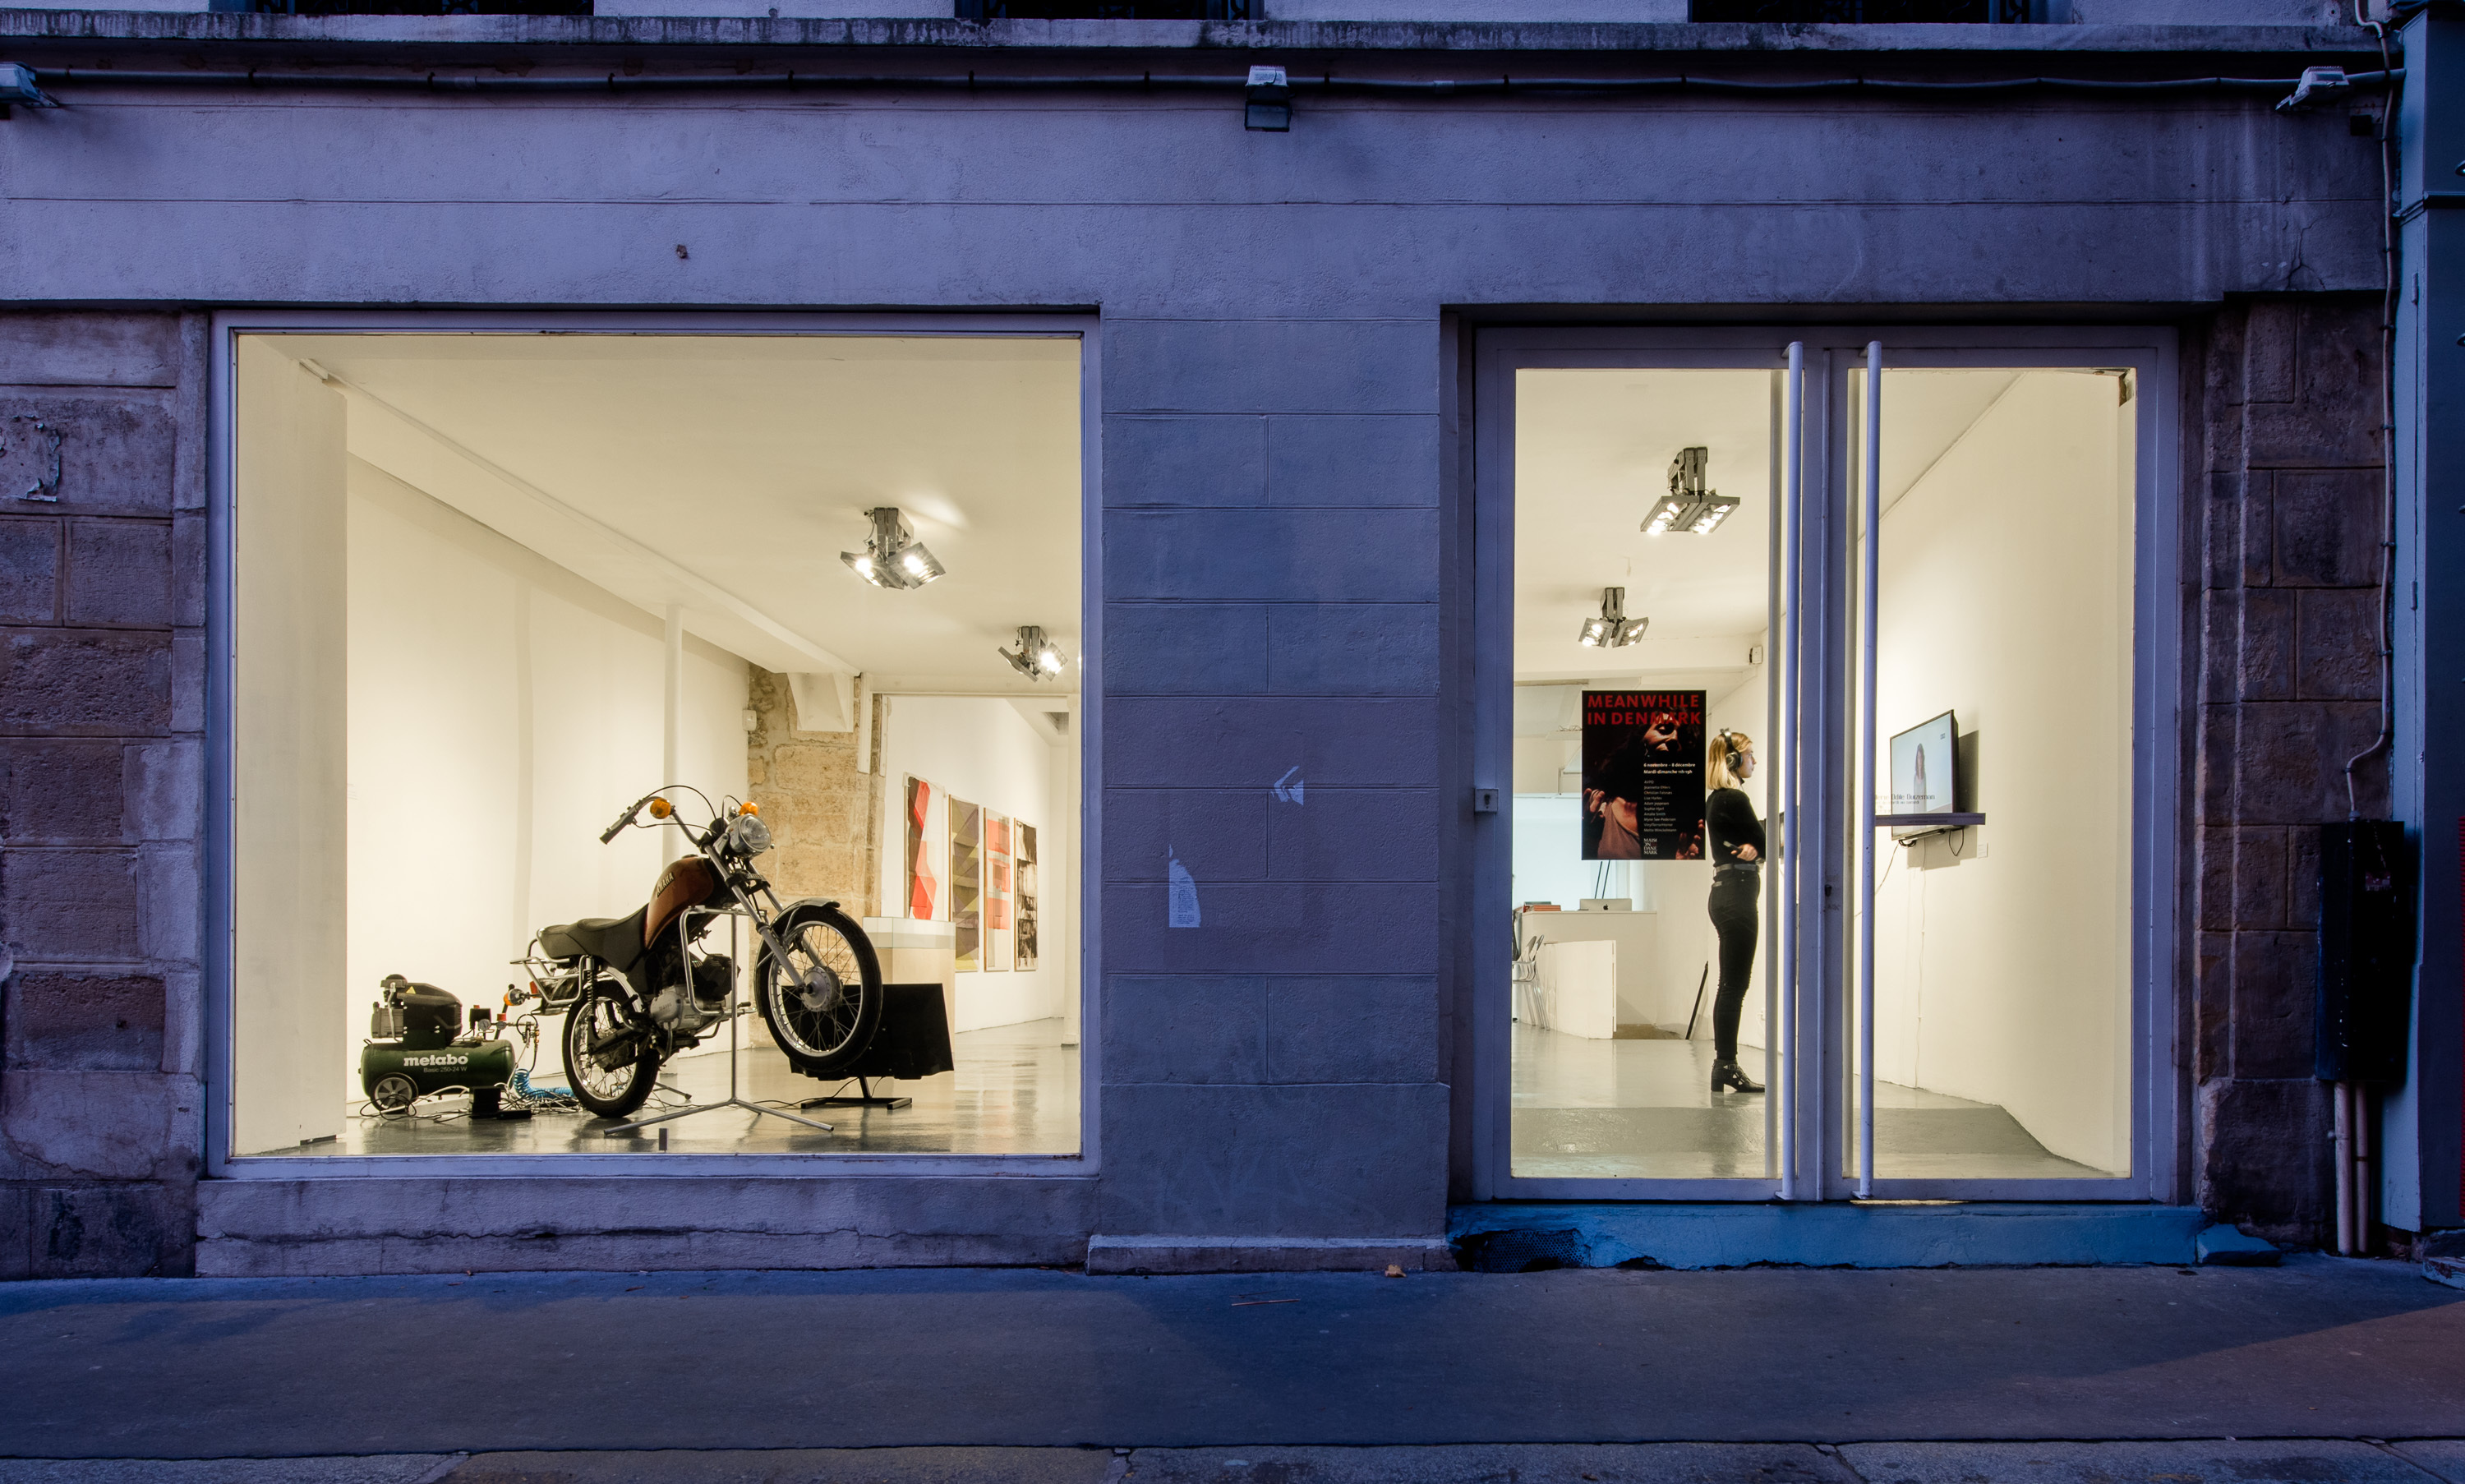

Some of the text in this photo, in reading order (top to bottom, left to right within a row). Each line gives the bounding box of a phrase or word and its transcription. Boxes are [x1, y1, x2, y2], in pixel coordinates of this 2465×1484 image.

[1587, 694, 1699, 707] MEANWHILE
[1587, 712, 1701, 725] IN DENMARK
[403, 1053, 468, 1067] metabo
